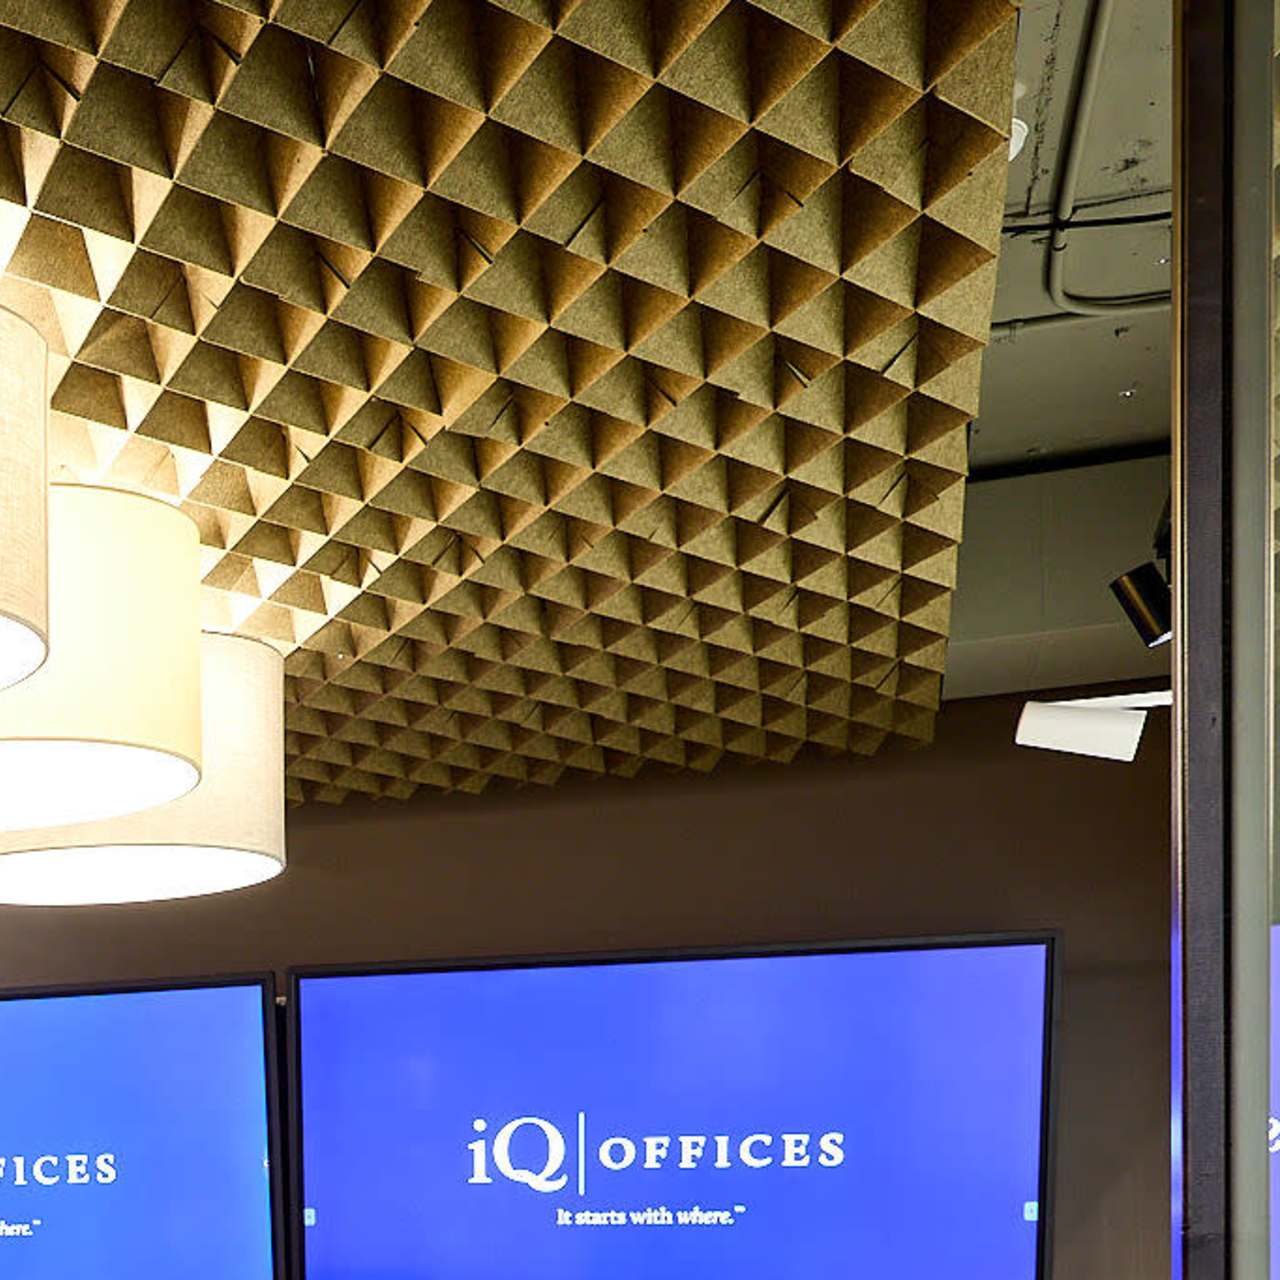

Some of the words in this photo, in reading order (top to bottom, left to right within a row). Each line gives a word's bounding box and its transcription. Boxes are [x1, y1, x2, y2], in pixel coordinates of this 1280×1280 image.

[467, 1116, 569, 1194] iQ
[598, 1131, 846, 1171] OFFICES
[556, 1208, 573, 1226] It
[575, 1208, 627, 1226] starts
[629, 1205, 674, 1225] with
